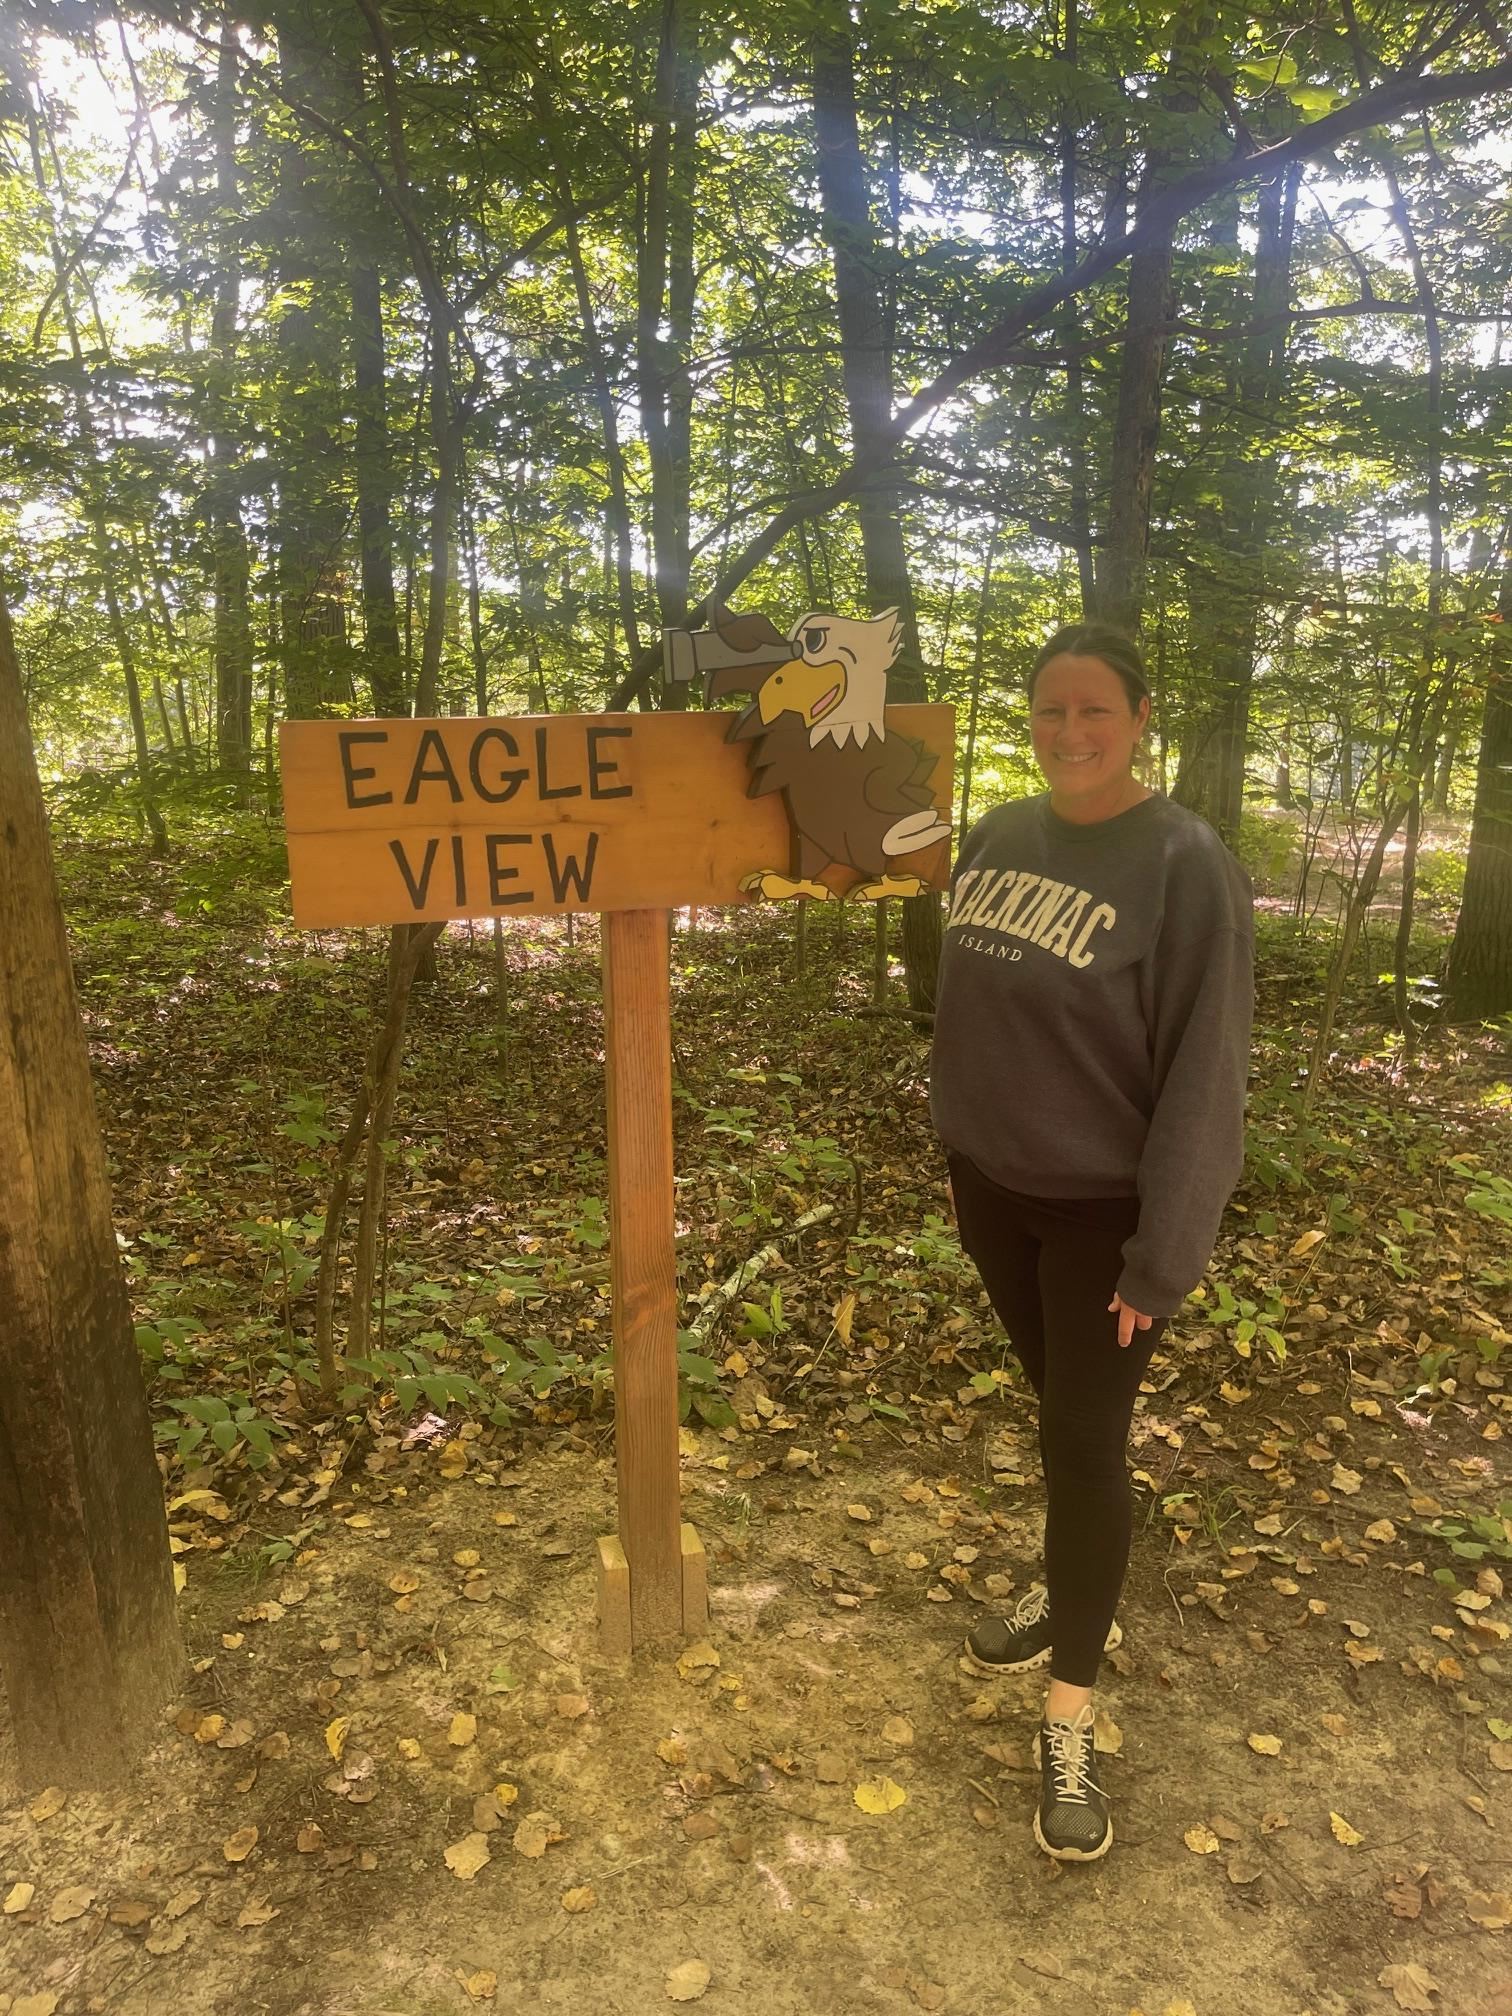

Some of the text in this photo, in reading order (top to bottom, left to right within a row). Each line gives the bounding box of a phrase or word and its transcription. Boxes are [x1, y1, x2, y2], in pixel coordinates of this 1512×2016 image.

[338, 727, 633, 809] EAGLE
[388, 831, 599, 910] VIEW
[958, 934, 1023, 962] ISLAND
